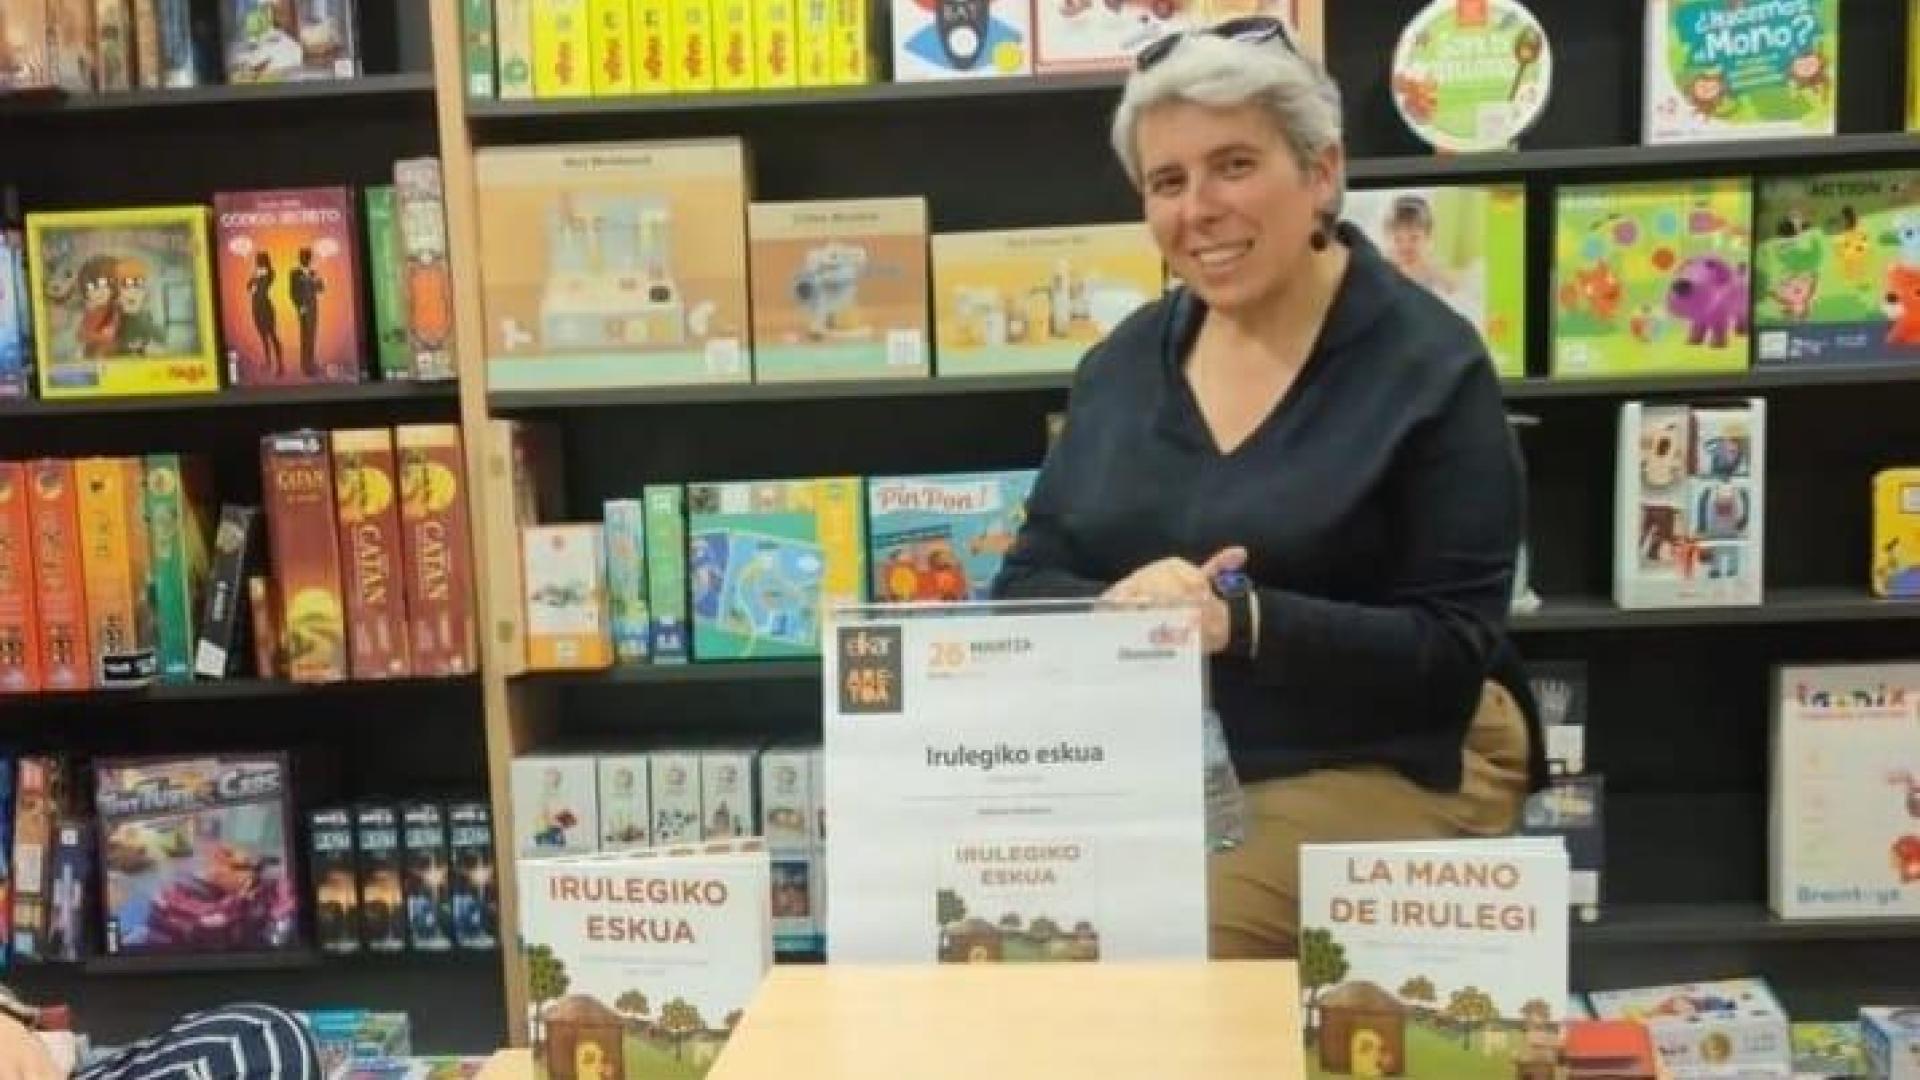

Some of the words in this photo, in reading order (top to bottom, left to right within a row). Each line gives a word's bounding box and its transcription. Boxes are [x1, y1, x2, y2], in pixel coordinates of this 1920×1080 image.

[928, 641, 966, 667] 26
[926, 742, 1028, 770] Irulegiko
[1036, 741, 1104, 764] eskua
[1347, 857, 1392, 883] LA
[1406, 859, 1520, 890] MANO
[548, 875, 729, 906] IRULEGIKO
[586, 916, 696, 944] ESKUA
[1330, 898, 1377, 924] DE
[1392, 900, 1537, 935] IRULEGI
